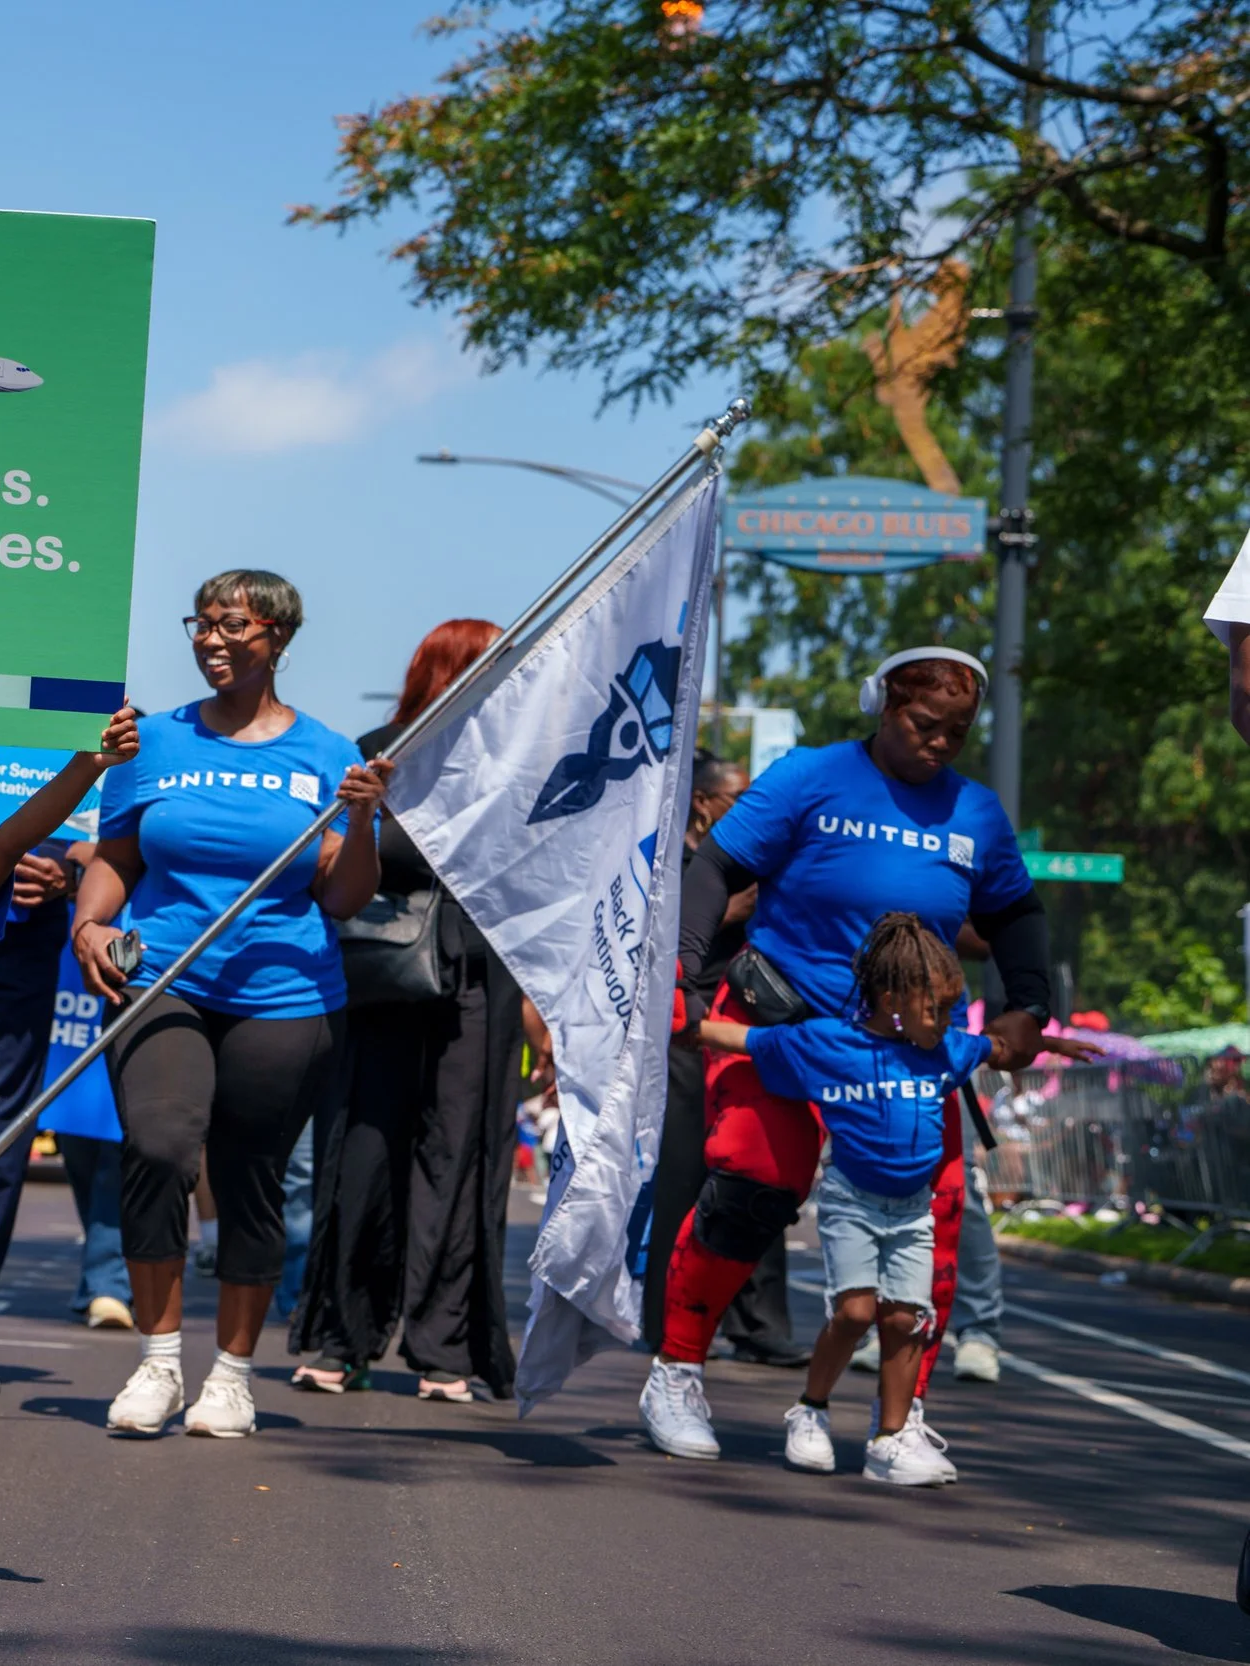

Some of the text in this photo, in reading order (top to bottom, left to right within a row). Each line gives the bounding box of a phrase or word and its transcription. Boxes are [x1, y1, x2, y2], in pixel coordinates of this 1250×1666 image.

[737, 510, 971, 538] CHICAGO BLUES
[9, 762, 58, 782] Servic
[158, 771, 283, 790] UNITED
[818, 815, 941, 852] UNITED
[610, 874, 636, 941] Black
[54, 990, 99, 1019] OD
[50, 1019, 90, 1049] HE
[823, 1080, 936, 1102] UNITED
